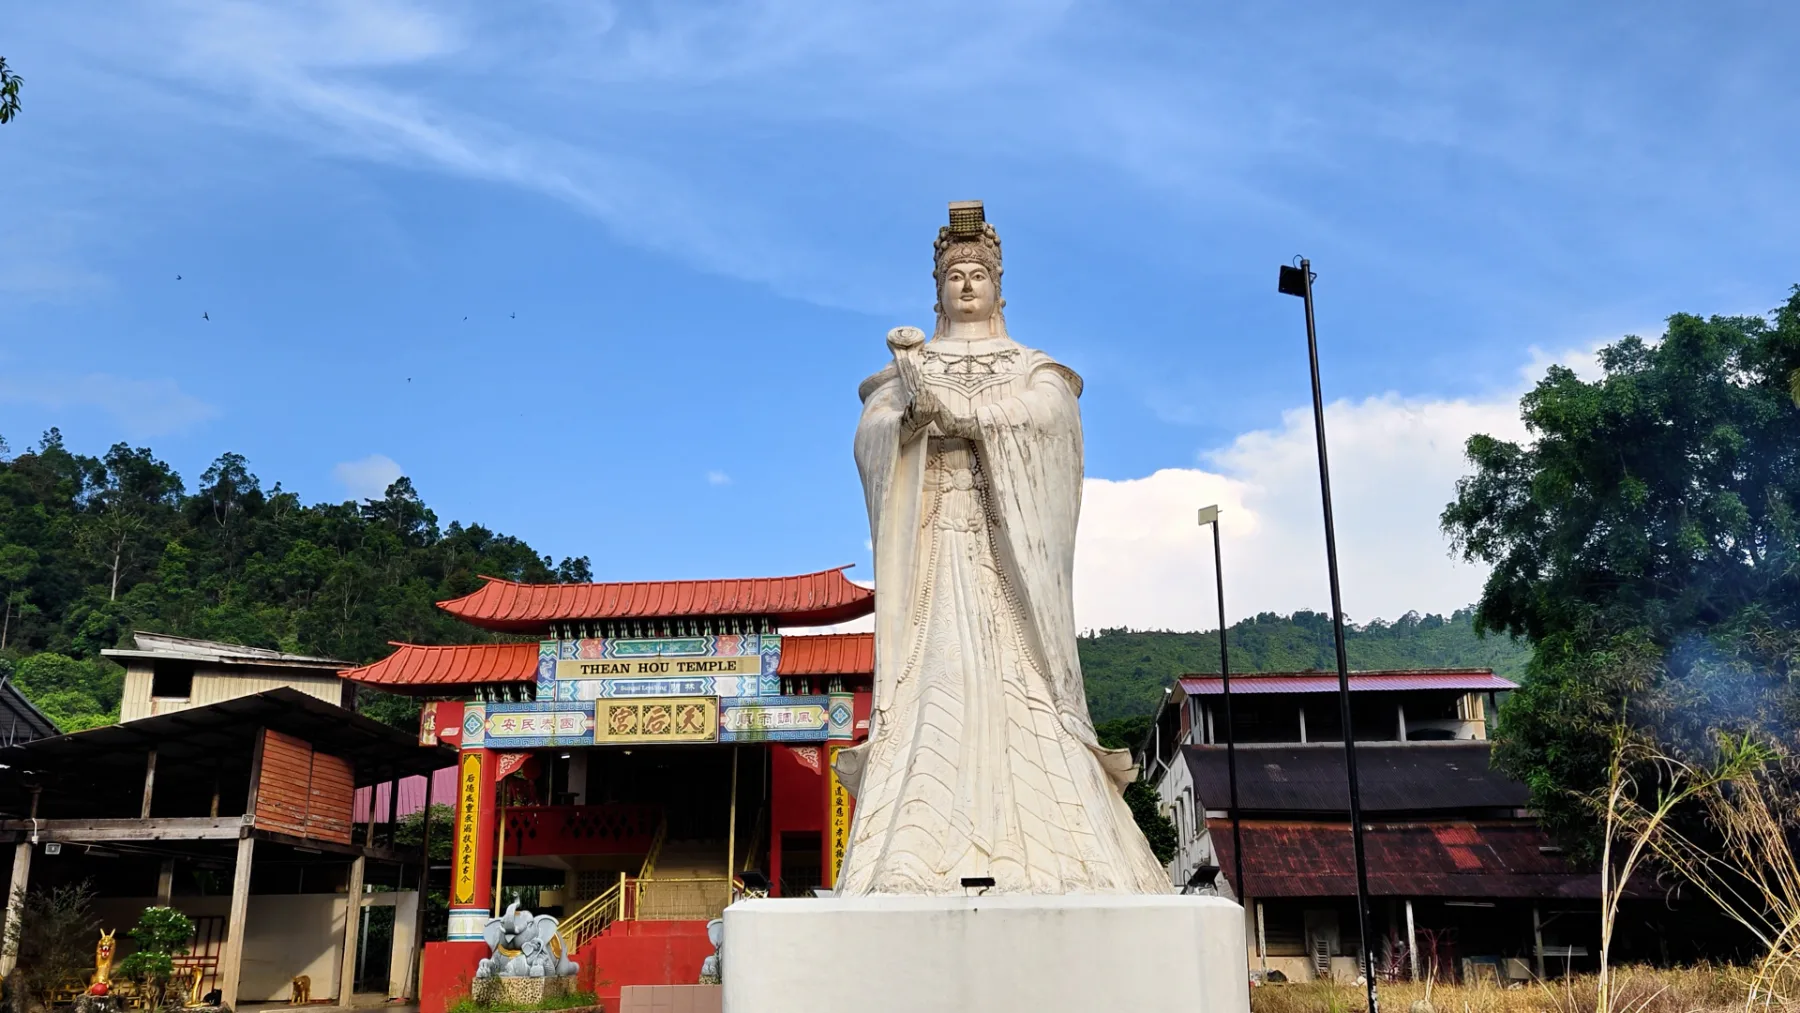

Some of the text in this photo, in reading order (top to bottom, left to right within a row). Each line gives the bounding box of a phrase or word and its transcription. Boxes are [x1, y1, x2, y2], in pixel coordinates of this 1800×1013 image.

[580, 660, 737, 675] THEAN HOU TEMPLE
